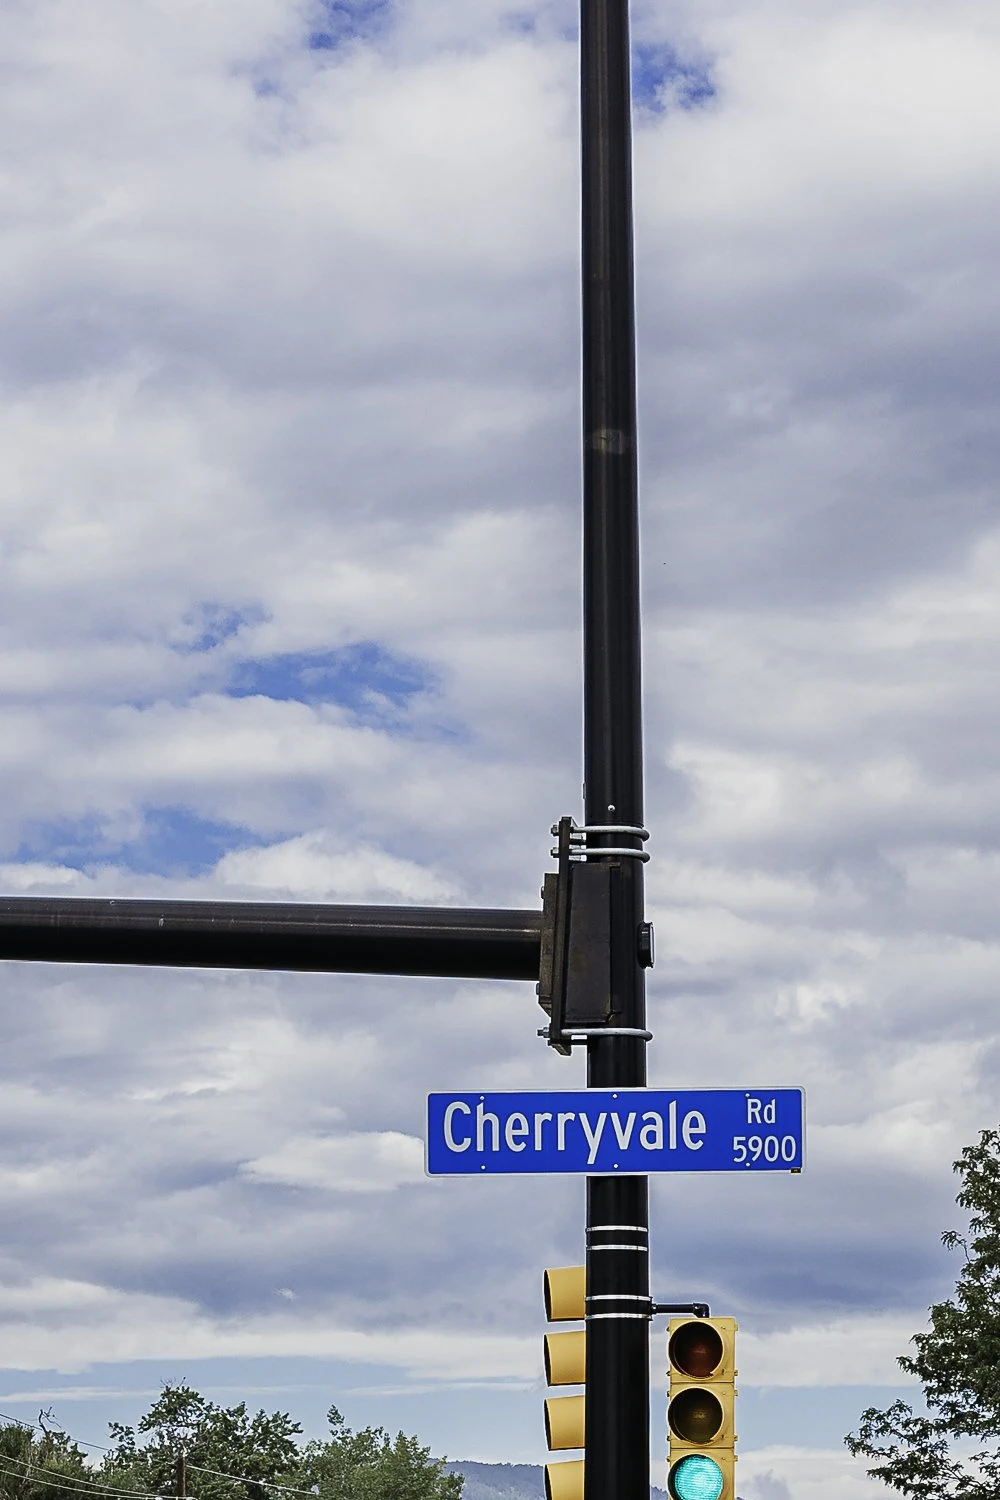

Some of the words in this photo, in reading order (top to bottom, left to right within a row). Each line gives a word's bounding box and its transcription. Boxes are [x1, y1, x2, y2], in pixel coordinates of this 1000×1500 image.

[443, 1100, 706, 1165] Cherryvale
[747, 1098, 776, 1124] Rd
[732, 1135, 797, 1163] 5900
